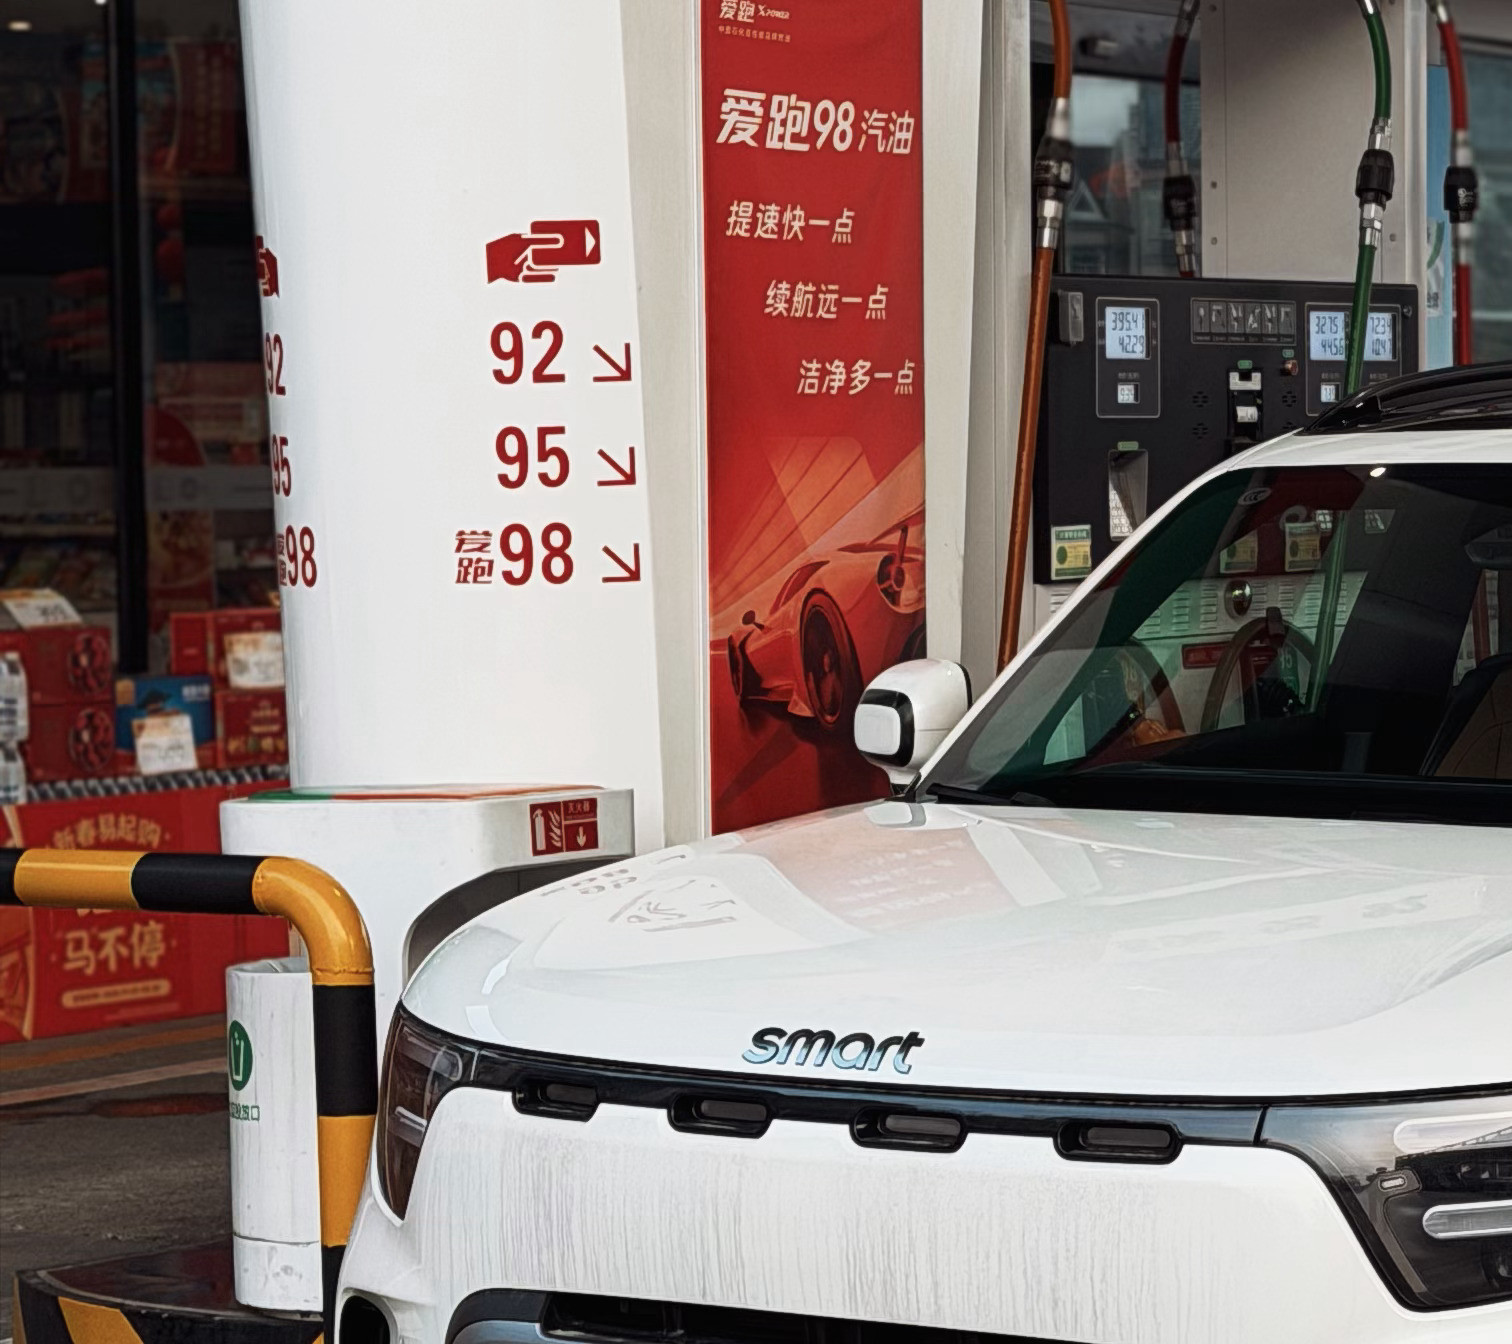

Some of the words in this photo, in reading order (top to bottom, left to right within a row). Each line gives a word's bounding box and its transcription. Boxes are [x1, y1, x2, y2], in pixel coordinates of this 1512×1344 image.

[725, 199, 855, 244] 提速快一点
[763, 278, 889, 321] 续航远一点
[490, 320, 567, 385] 92
[796, 358, 916, 396] 洁净多一点
[495, 425, 570, 489] 95
[499, 521, 574, 586] 98
[62, 920, 166, 976] 马不停
[741, 1026, 926, 1075] smart
